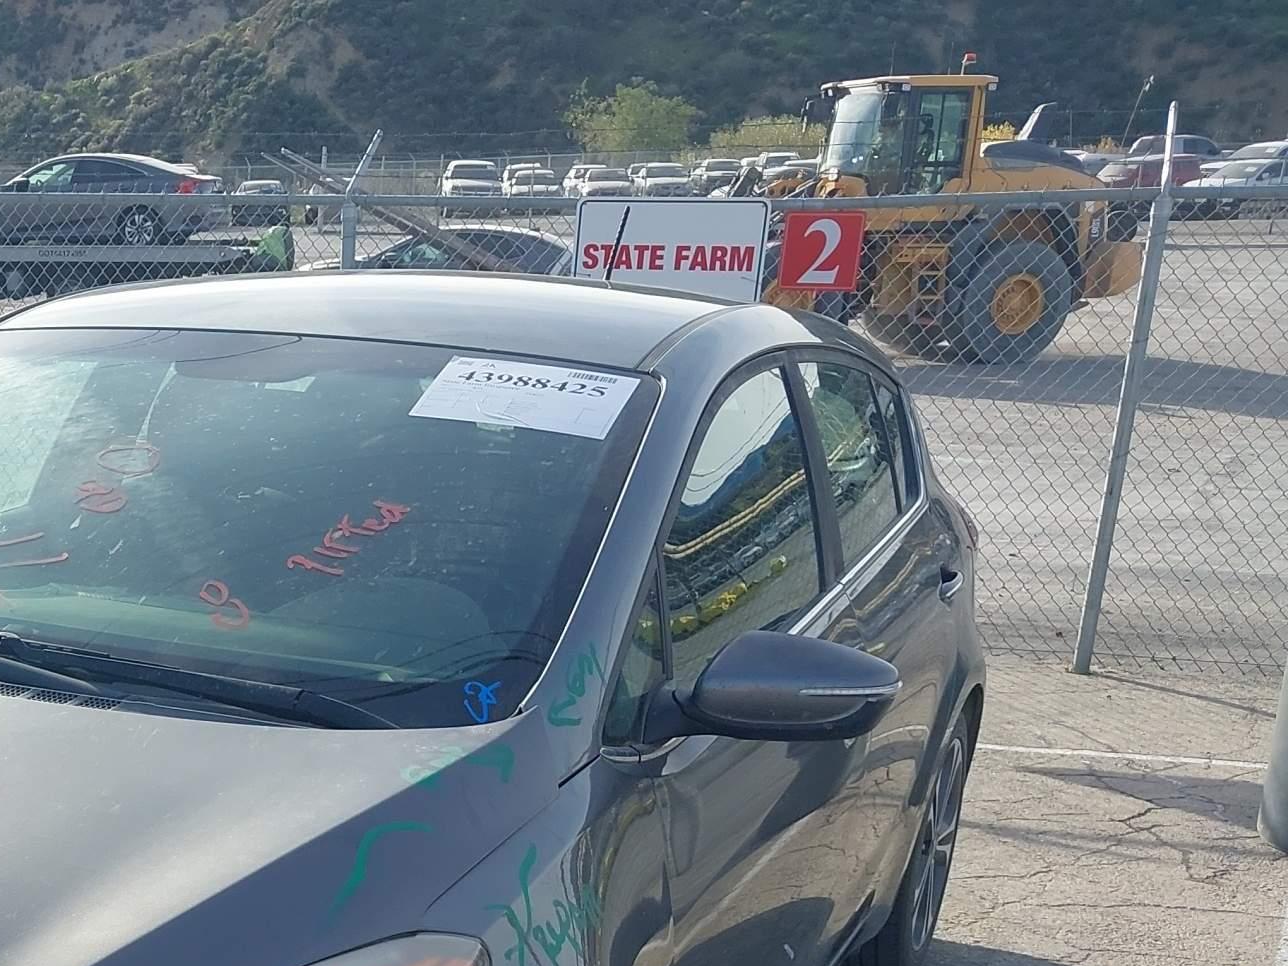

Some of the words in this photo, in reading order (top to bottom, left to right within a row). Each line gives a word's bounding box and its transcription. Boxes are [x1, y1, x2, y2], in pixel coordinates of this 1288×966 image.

[581, 243, 666, 271] STATE
[673, 244, 756, 273] FARM
[795, 217, 843, 285] 2
[457, 370, 609, 398] 43988425
